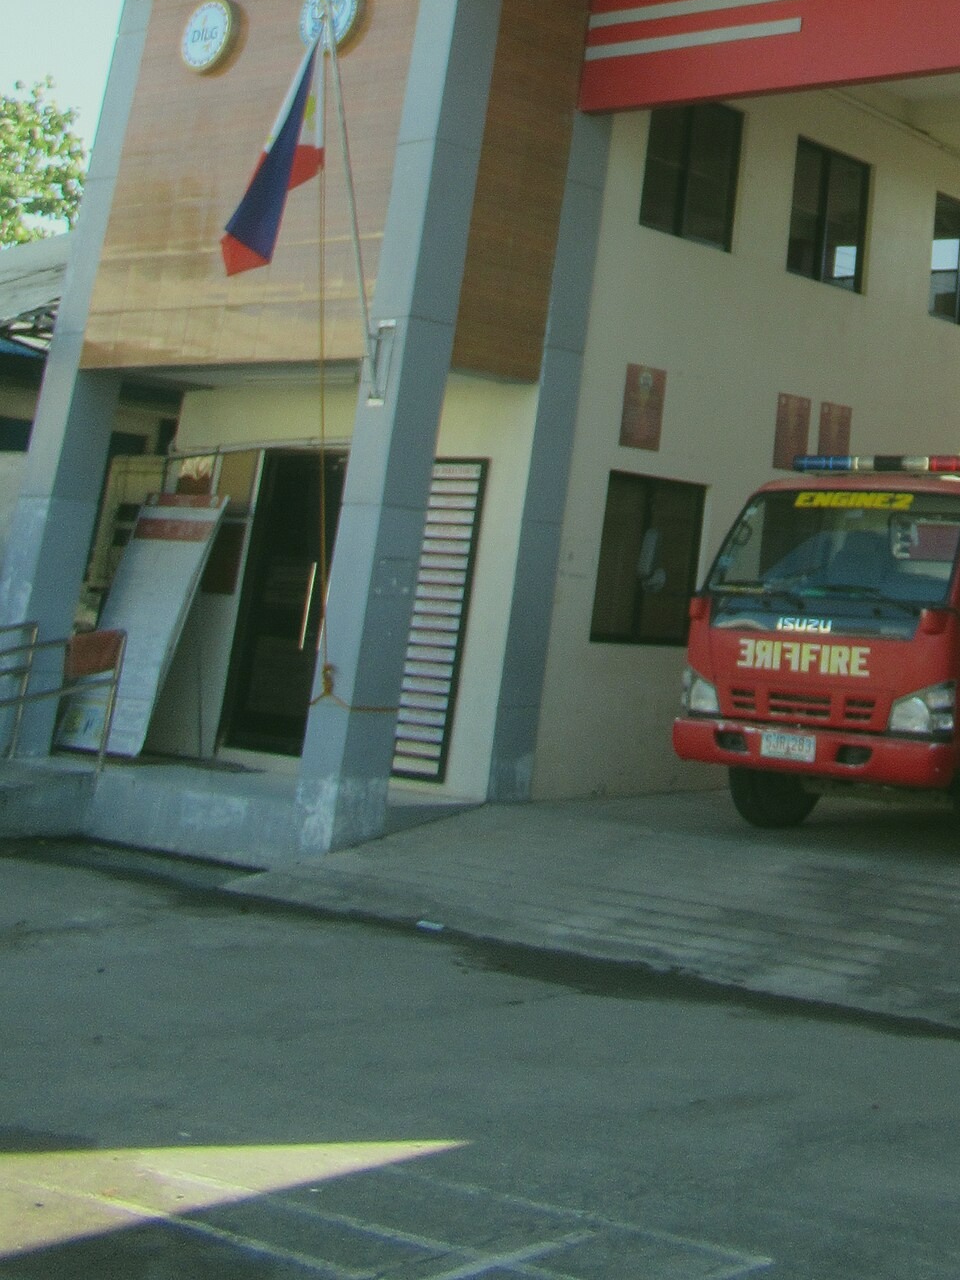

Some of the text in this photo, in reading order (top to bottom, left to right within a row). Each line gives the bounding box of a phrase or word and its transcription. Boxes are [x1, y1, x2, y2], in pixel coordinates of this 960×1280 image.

[191, 25, 220, 44] DILG
[776, 616, 832, 634] ISUZU
[800, 642, 871, 677] FIRE
